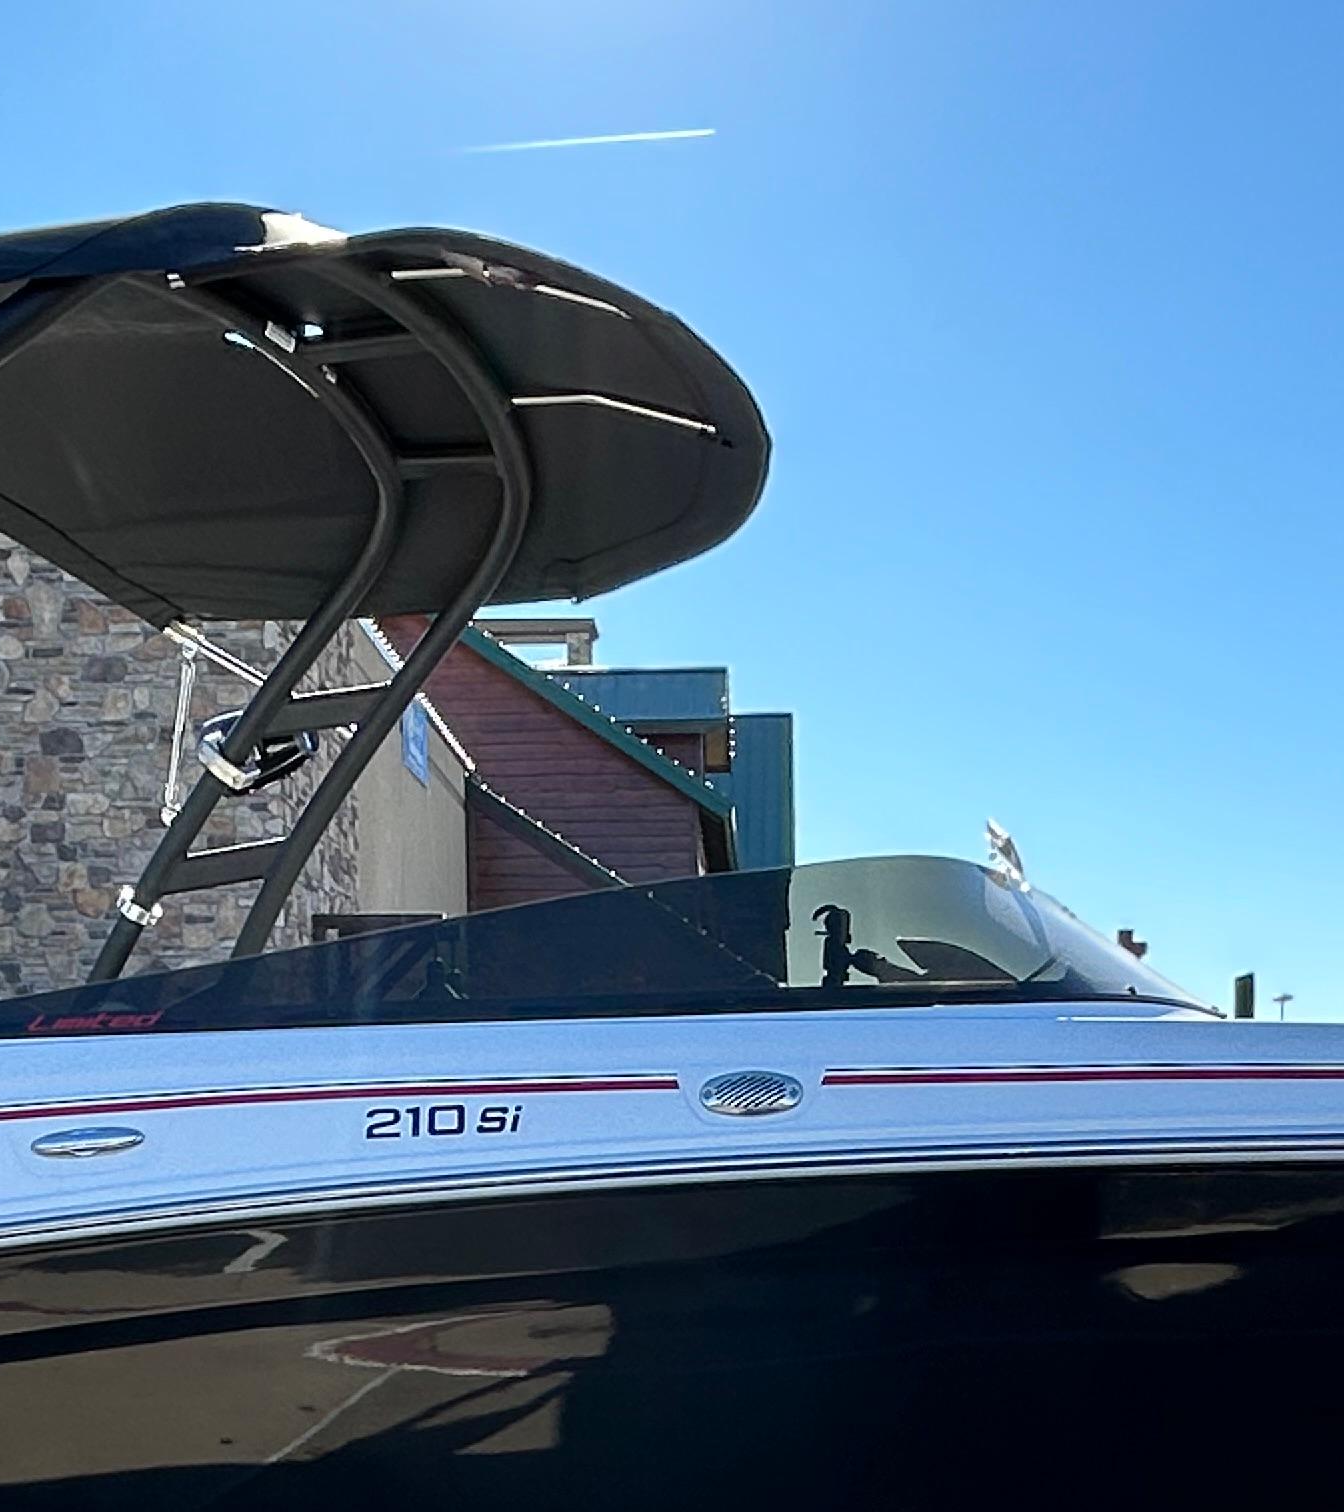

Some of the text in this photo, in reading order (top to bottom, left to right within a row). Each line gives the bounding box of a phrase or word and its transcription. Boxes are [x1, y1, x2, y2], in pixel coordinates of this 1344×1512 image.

[27, 1008, 165, 1033] Limited
[366, 1104, 524, 1140] 210 Si
